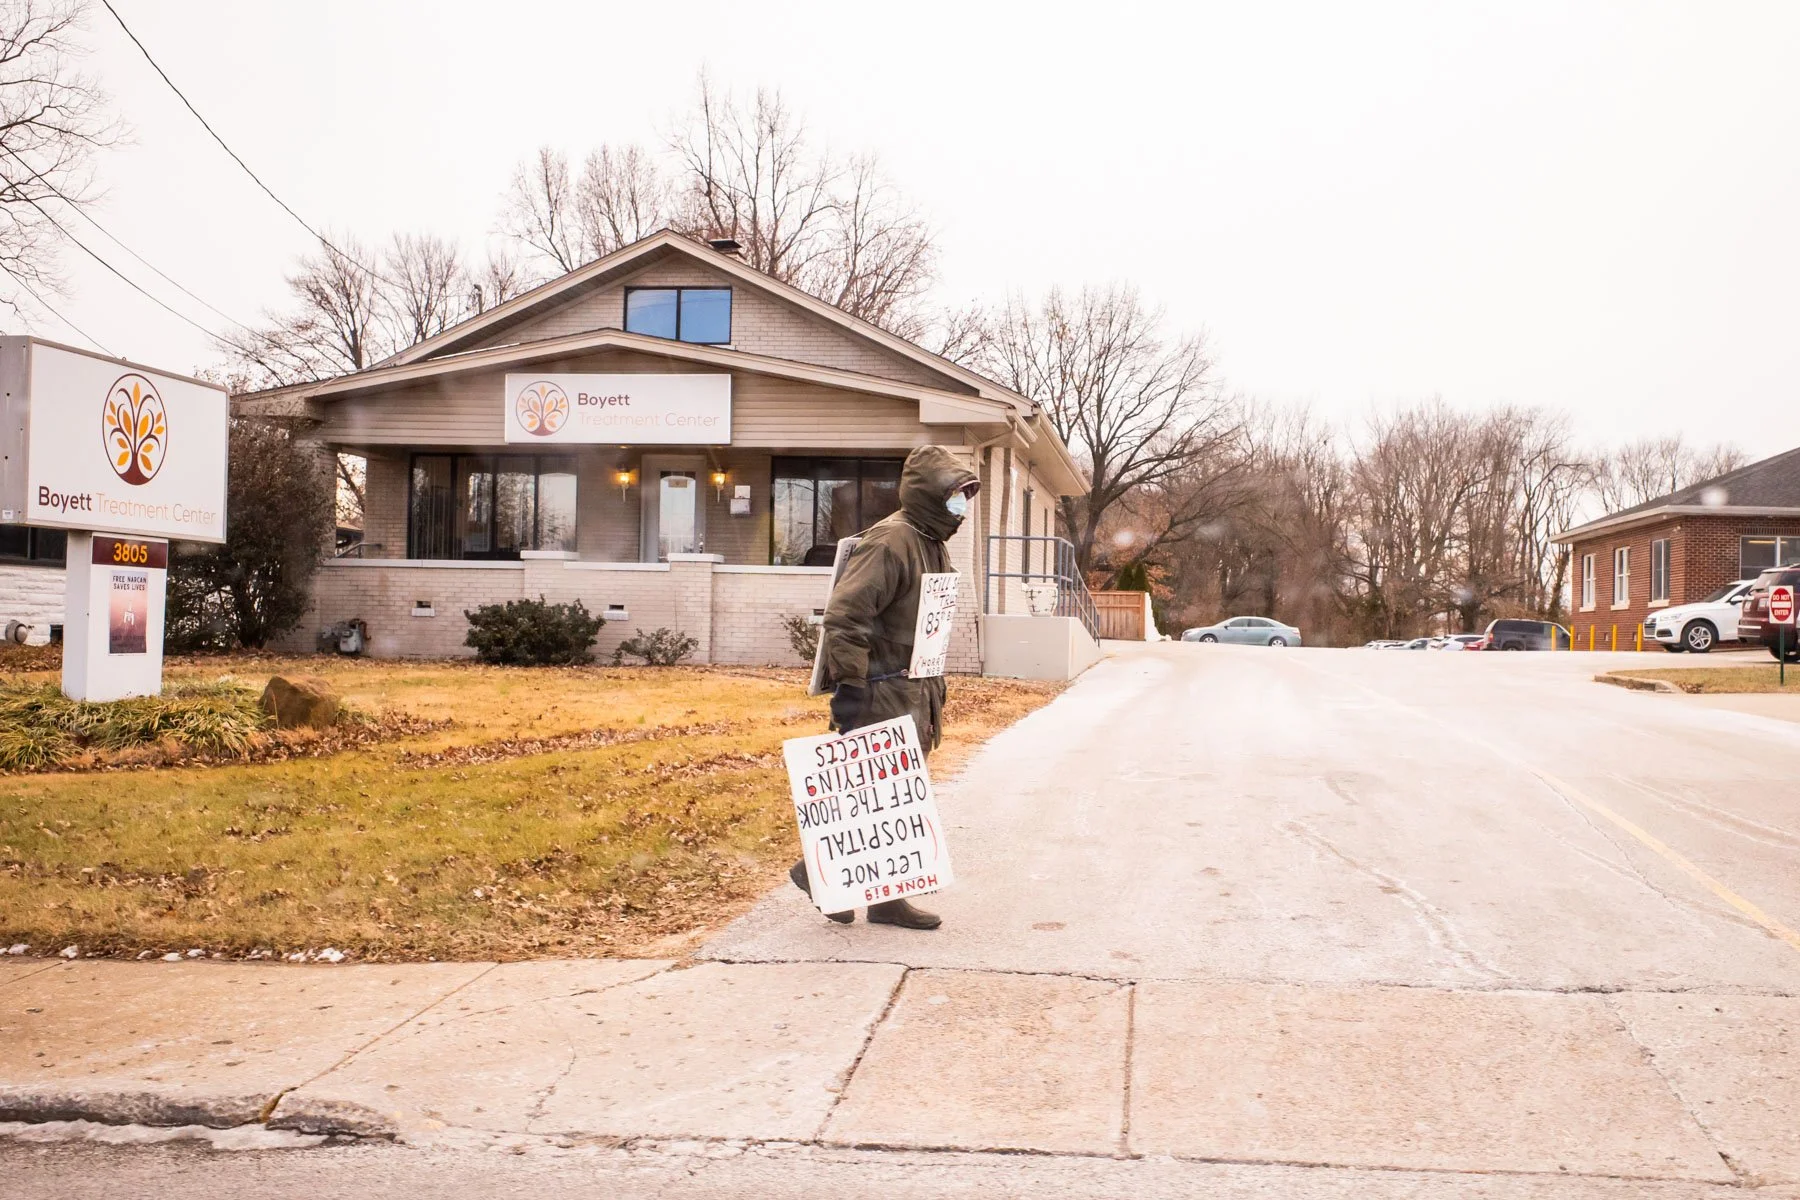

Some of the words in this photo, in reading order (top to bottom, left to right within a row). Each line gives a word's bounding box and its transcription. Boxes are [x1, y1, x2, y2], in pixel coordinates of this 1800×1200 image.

[578, 393, 630, 409] Boyett
[578, 412, 660, 427] Treatment
[665, 412, 720, 427] Center
[38, 486, 92, 513] Boyett
[96, 493, 169, 520] Treatment
[172, 503, 217, 525] Center
[113, 542, 148, 563] 3805
[112, 575, 125, 583] FREE
[127, 576, 147, 584] NARCAN
[846, 787, 883, 818] The
[890, 776, 927, 808] OFF
[886, 851, 923, 876] Let
[895, 874, 938, 894] HONK
